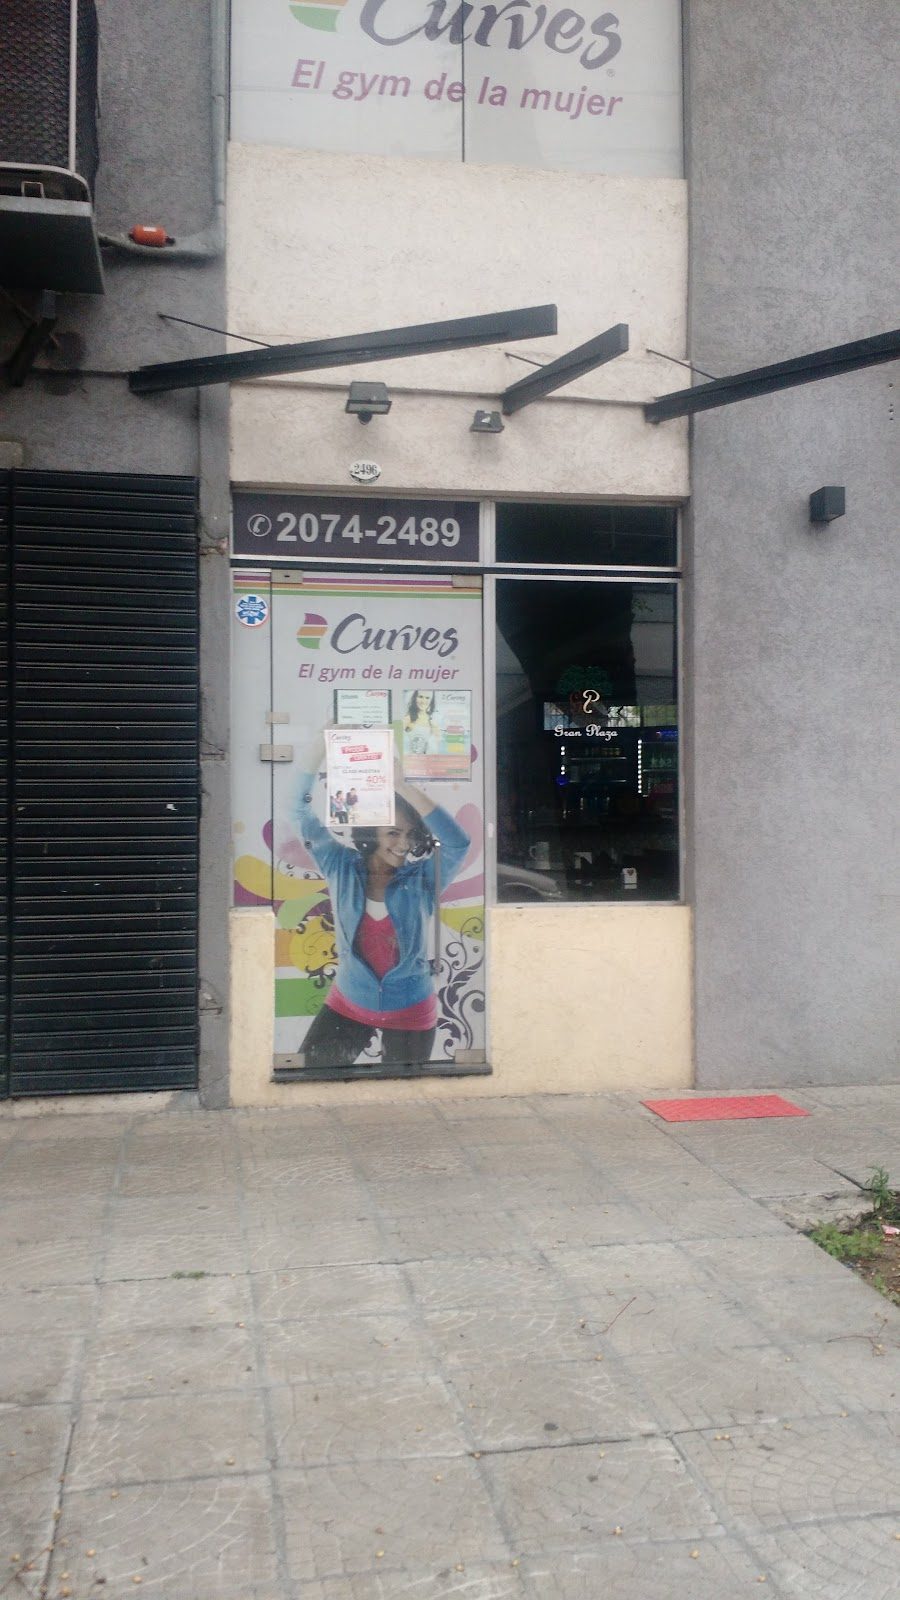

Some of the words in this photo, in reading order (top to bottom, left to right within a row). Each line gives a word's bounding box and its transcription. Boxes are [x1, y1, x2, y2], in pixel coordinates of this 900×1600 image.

[359, 0, 622, 71] Curves
[291, 58, 325, 89] El
[332, 70, 411, 102] gym
[424, 72, 466, 102] de
[478, 76, 508, 107] la
[520, 85, 623, 120] mujer
[353, 463, 378, 475] 2496
[277, 512, 461, 547] 2074-2489
[330, 612, 459, 657] Curves
[298, 663, 315, 679] El
[318, 668, 355, 682] gym
[361, 665, 382, 680] de
[388, 665, 403, 680] la
[408, 666, 459, 682] mujer
[554, 724, 582, 737] Gran
[585, 723, 618, 741] Plaza
